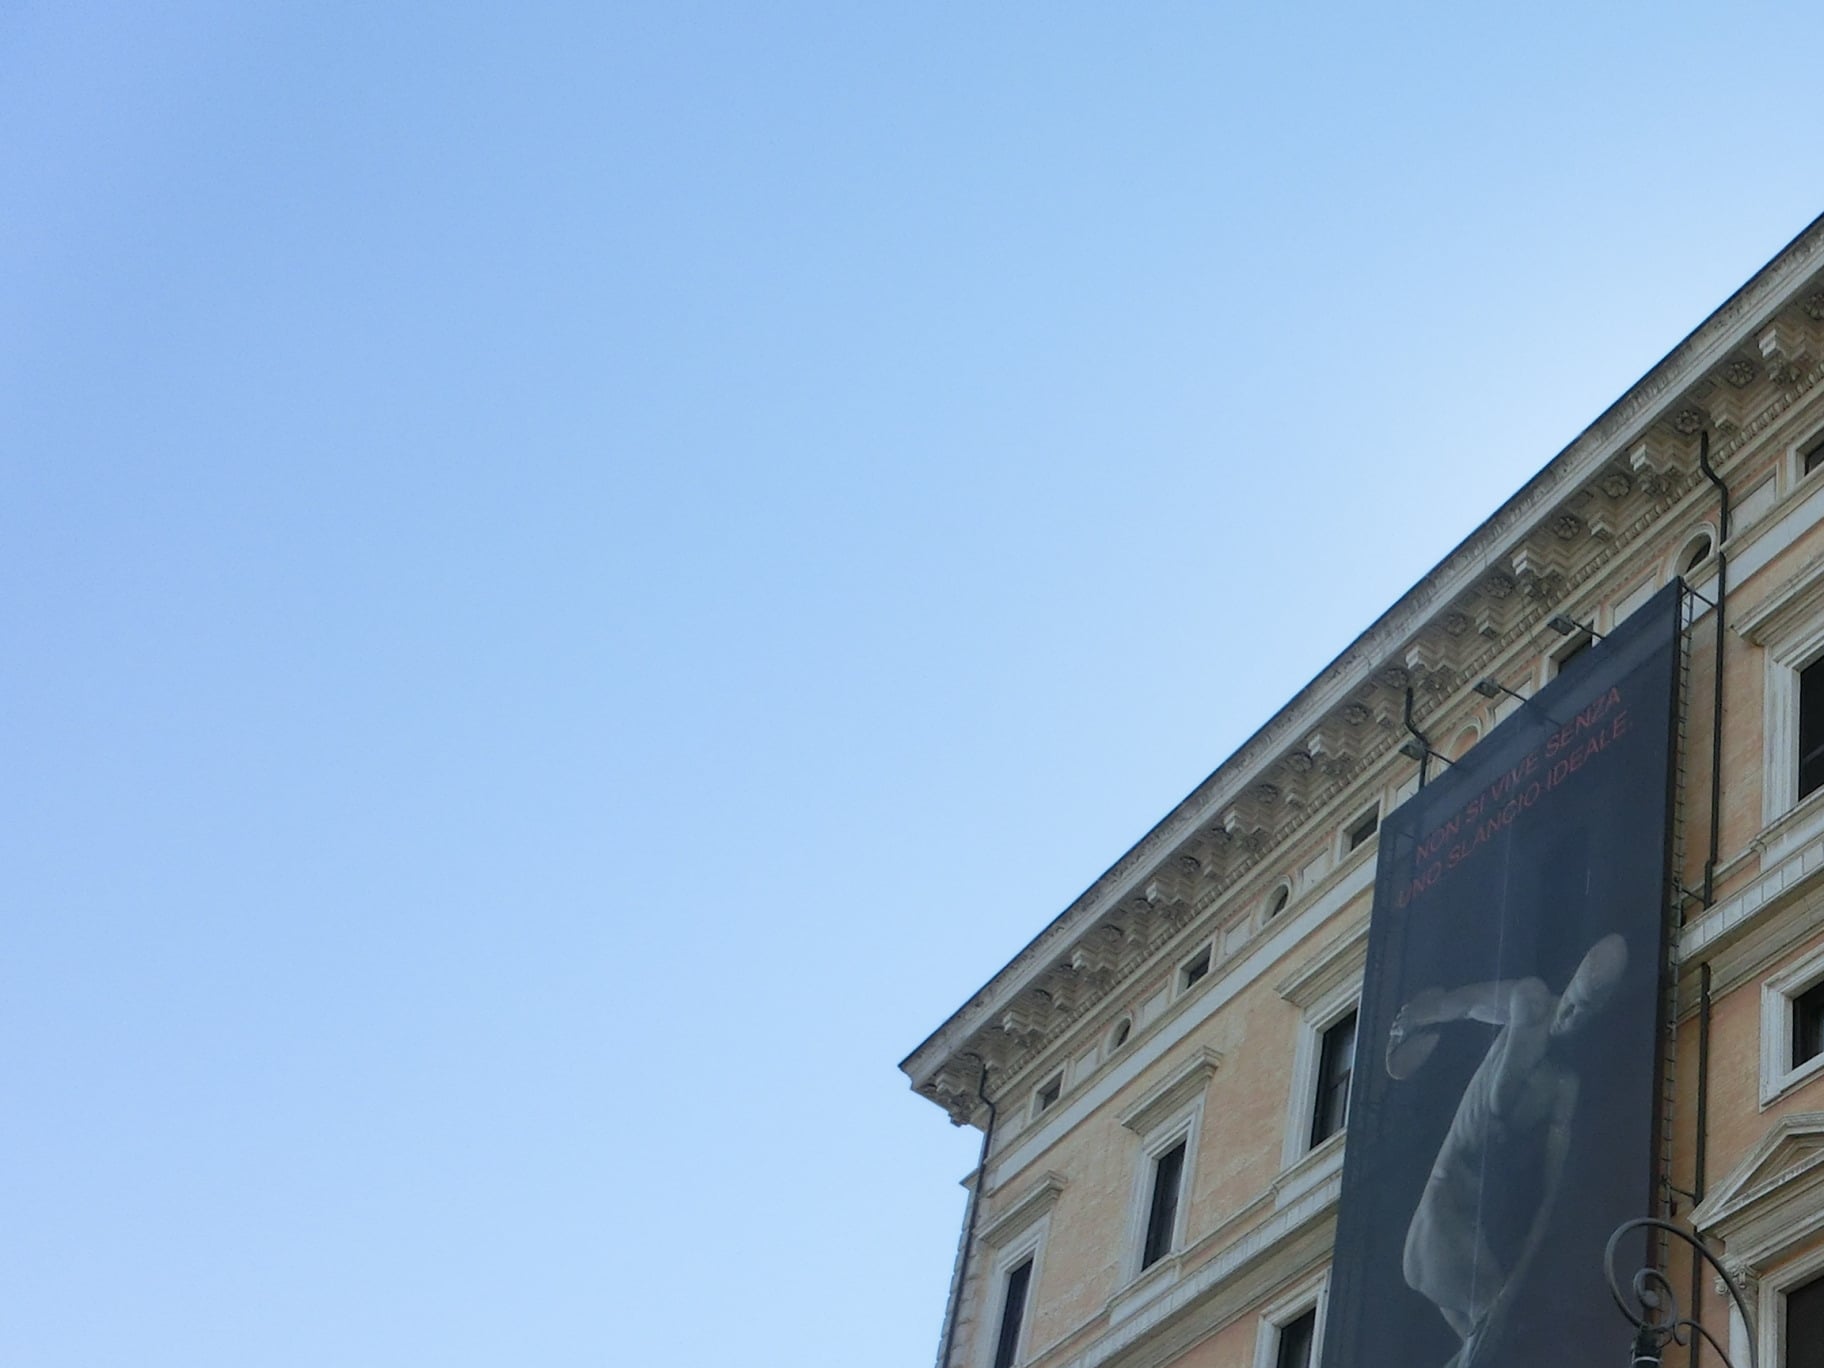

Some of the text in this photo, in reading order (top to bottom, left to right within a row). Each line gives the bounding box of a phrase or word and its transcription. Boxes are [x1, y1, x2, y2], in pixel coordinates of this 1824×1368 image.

[1397, 860, 1443, 908] UNO
[1447, 782, 1541, 868] SLANCIO
[1415, 686, 1621, 866] NON SI VIVE SENZA
